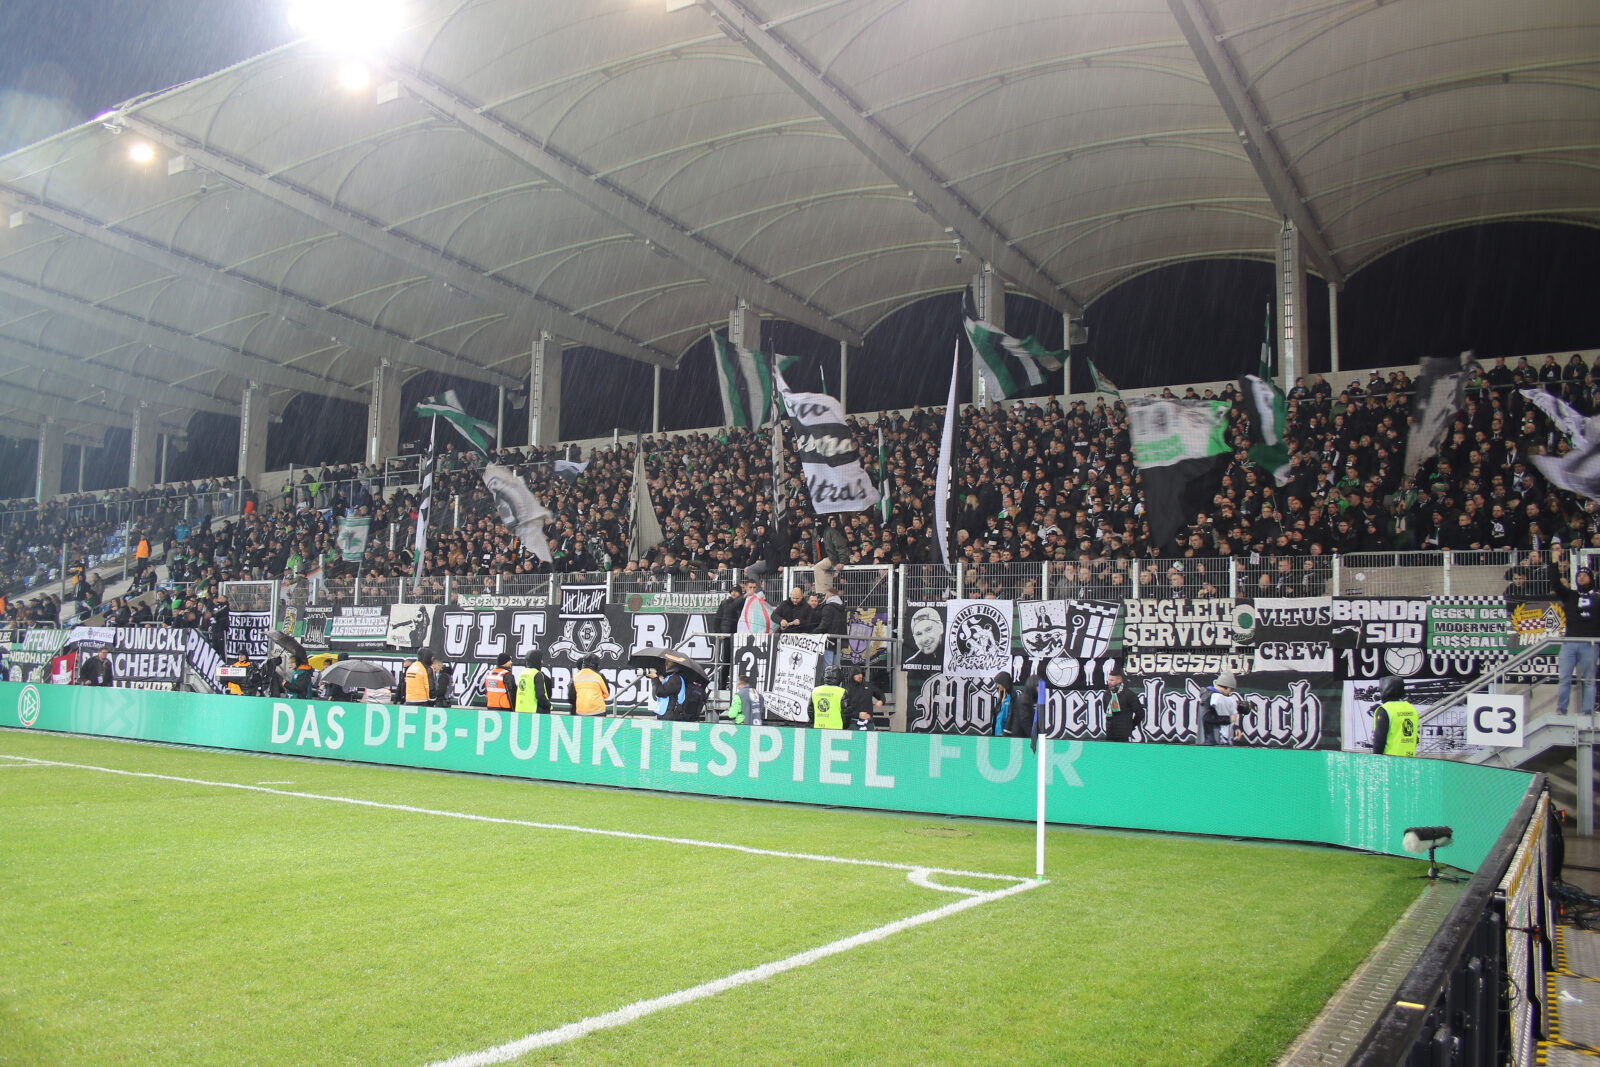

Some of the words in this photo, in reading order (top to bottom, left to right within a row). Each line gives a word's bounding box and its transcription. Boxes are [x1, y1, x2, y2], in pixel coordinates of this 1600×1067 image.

[458, 595, 548, 607] ASCENDENTE
[1124, 599, 1235, 623] BEGLEIT
[1333, 600, 1426, 620] BANDA
[1258, 606, 1333, 626] VITUS
[1431, 608, 1475, 619] GEGEN
[1480, 608, 1507, 619] DEN
[227, 627, 247, 641] PER
[1122, 623, 1233, 646] SERVICE
[1434, 622, 1506, 633] MODERNEN
[115, 627, 186, 651] PUMUCKL
[1259, 641, 1330, 660] CREW
[1473, 706, 1517, 734] C3
[270, 702, 346, 750] DAS
[363, 702, 896, 789] DFB-PUNKTESPIEL
